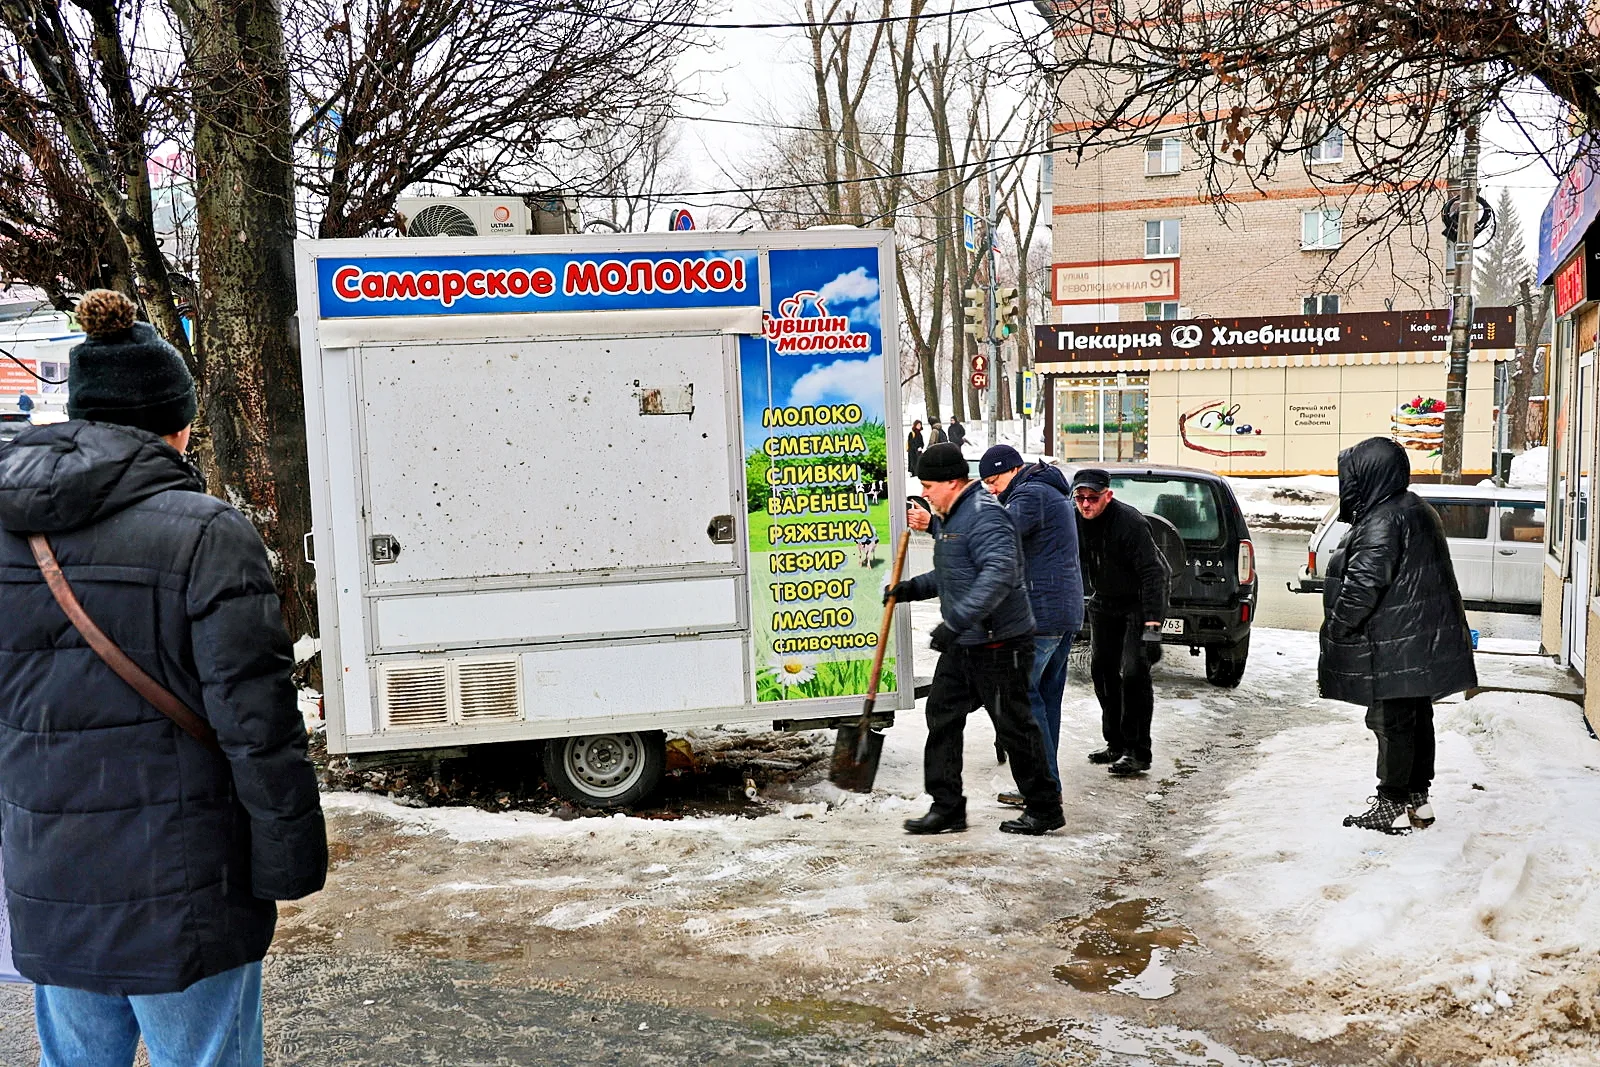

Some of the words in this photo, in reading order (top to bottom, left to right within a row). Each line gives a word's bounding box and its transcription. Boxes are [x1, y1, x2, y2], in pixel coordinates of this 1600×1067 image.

[333, 266, 554, 305] Самарское
[564, 258, 746, 294] МОЛОКО!
[1062, 281, 1148, 293] РЕВОЛЮЦИОННАЯ
[1150, 269, 1172, 289] 91
[1058, 331, 1162, 353] Пекарня
[1211, 325, 1341, 346] Хлебница
[1410, 324, 1438, 333] Кофе
[778, 334, 867, 351] молока
[763, 404, 862, 427] МОЛОКО
[1289, 404, 1317, 412] Горячий
[764, 434, 866, 456] СМЕТАНА
[766, 463, 858, 485] СЛИВКИ
[767, 491, 867, 515] ВАРЕНЕЦ
[769, 520, 873, 544] РЯЖЕНКА
[770, 550, 845, 574] КЕФИР
[769, 578, 855, 602] ТВОРОГ
[772, 607, 854, 632] МАСЛО
[773, 632, 878, 653] сливочное
